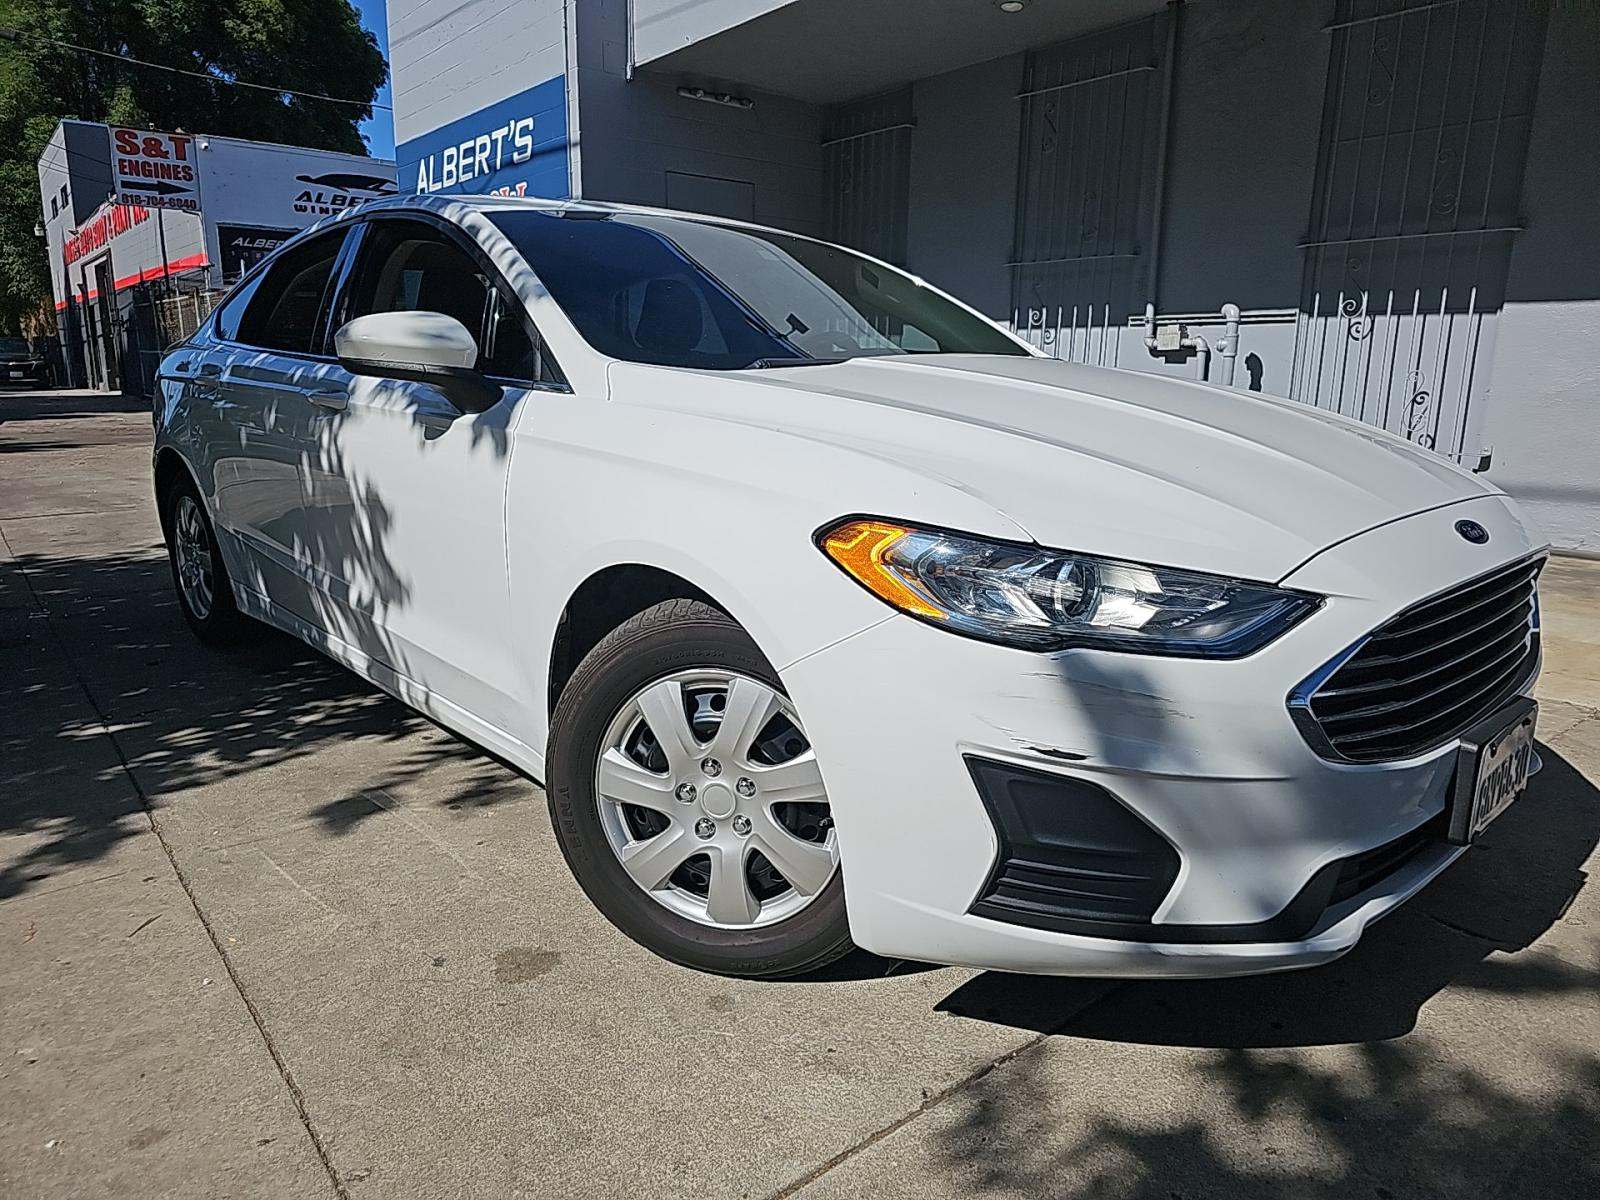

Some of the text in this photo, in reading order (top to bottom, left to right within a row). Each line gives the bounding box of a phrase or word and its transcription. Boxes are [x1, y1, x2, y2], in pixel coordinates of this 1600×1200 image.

[115, 130, 191, 161] S&T
[417, 117, 534, 195] ALBERT'S
[118, 158, 194, 182] ENGINES
